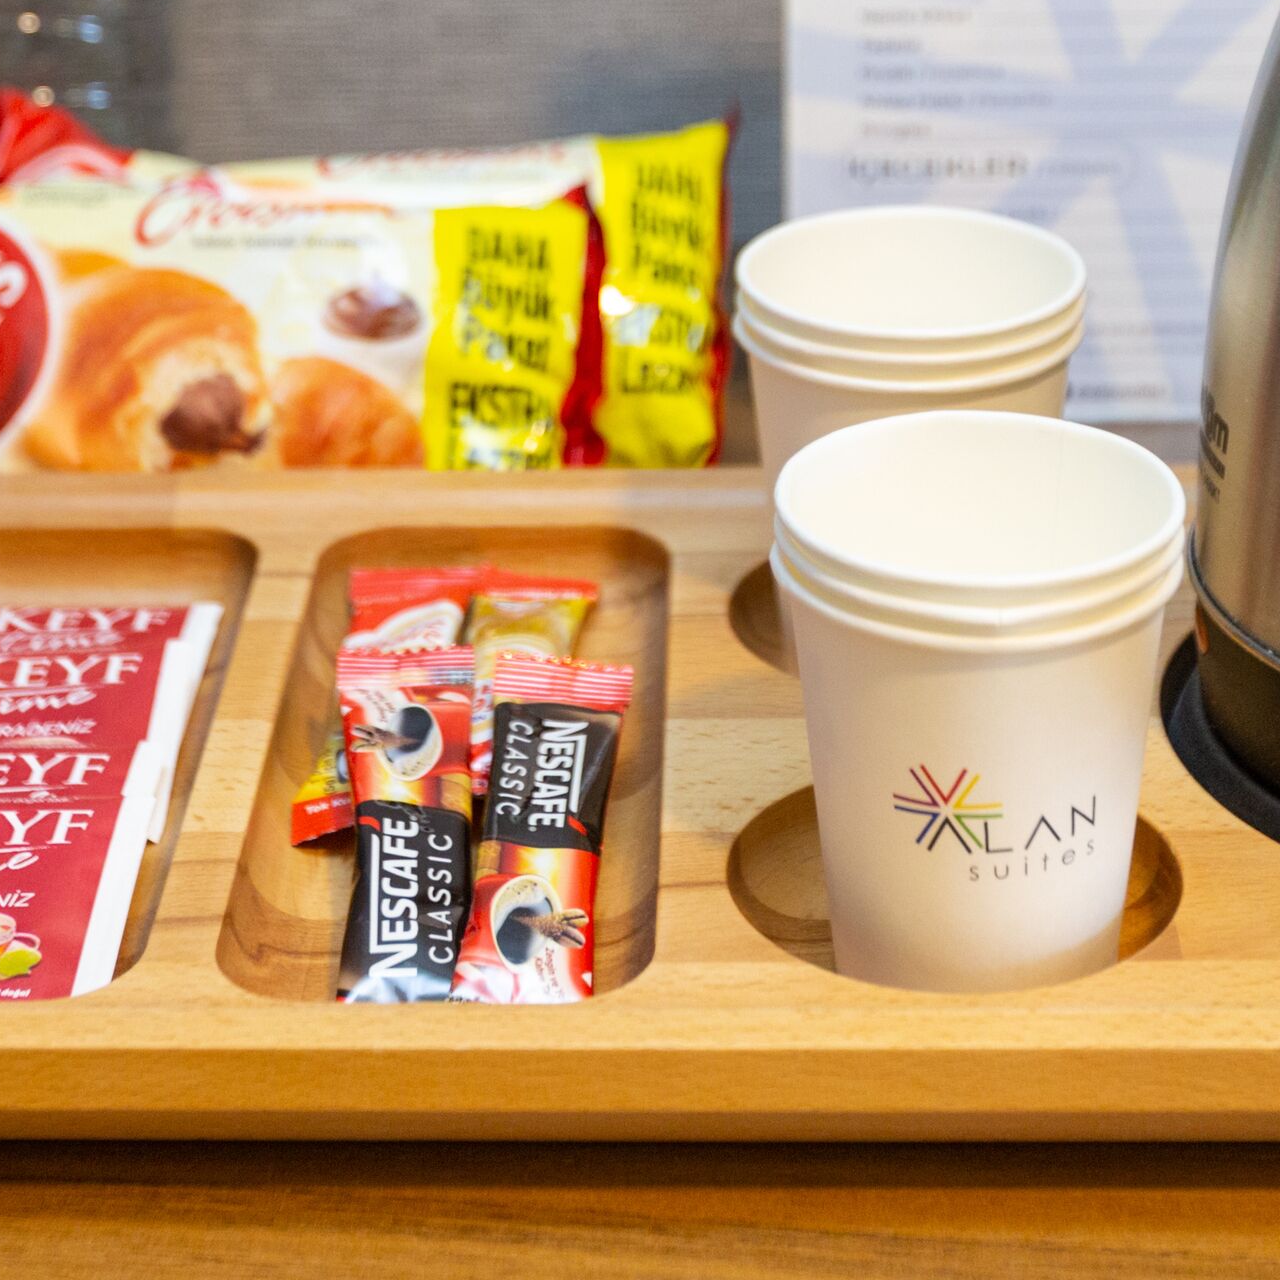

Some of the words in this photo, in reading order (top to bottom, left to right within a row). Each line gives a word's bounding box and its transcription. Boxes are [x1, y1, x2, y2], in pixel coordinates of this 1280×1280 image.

[495, 721, 534, 817] CLASSIC
[926, 793, 1098, 856] ALAN
[968, 838, 1096, 883] suites
[427, 833, 455, 964] CLASSIC
